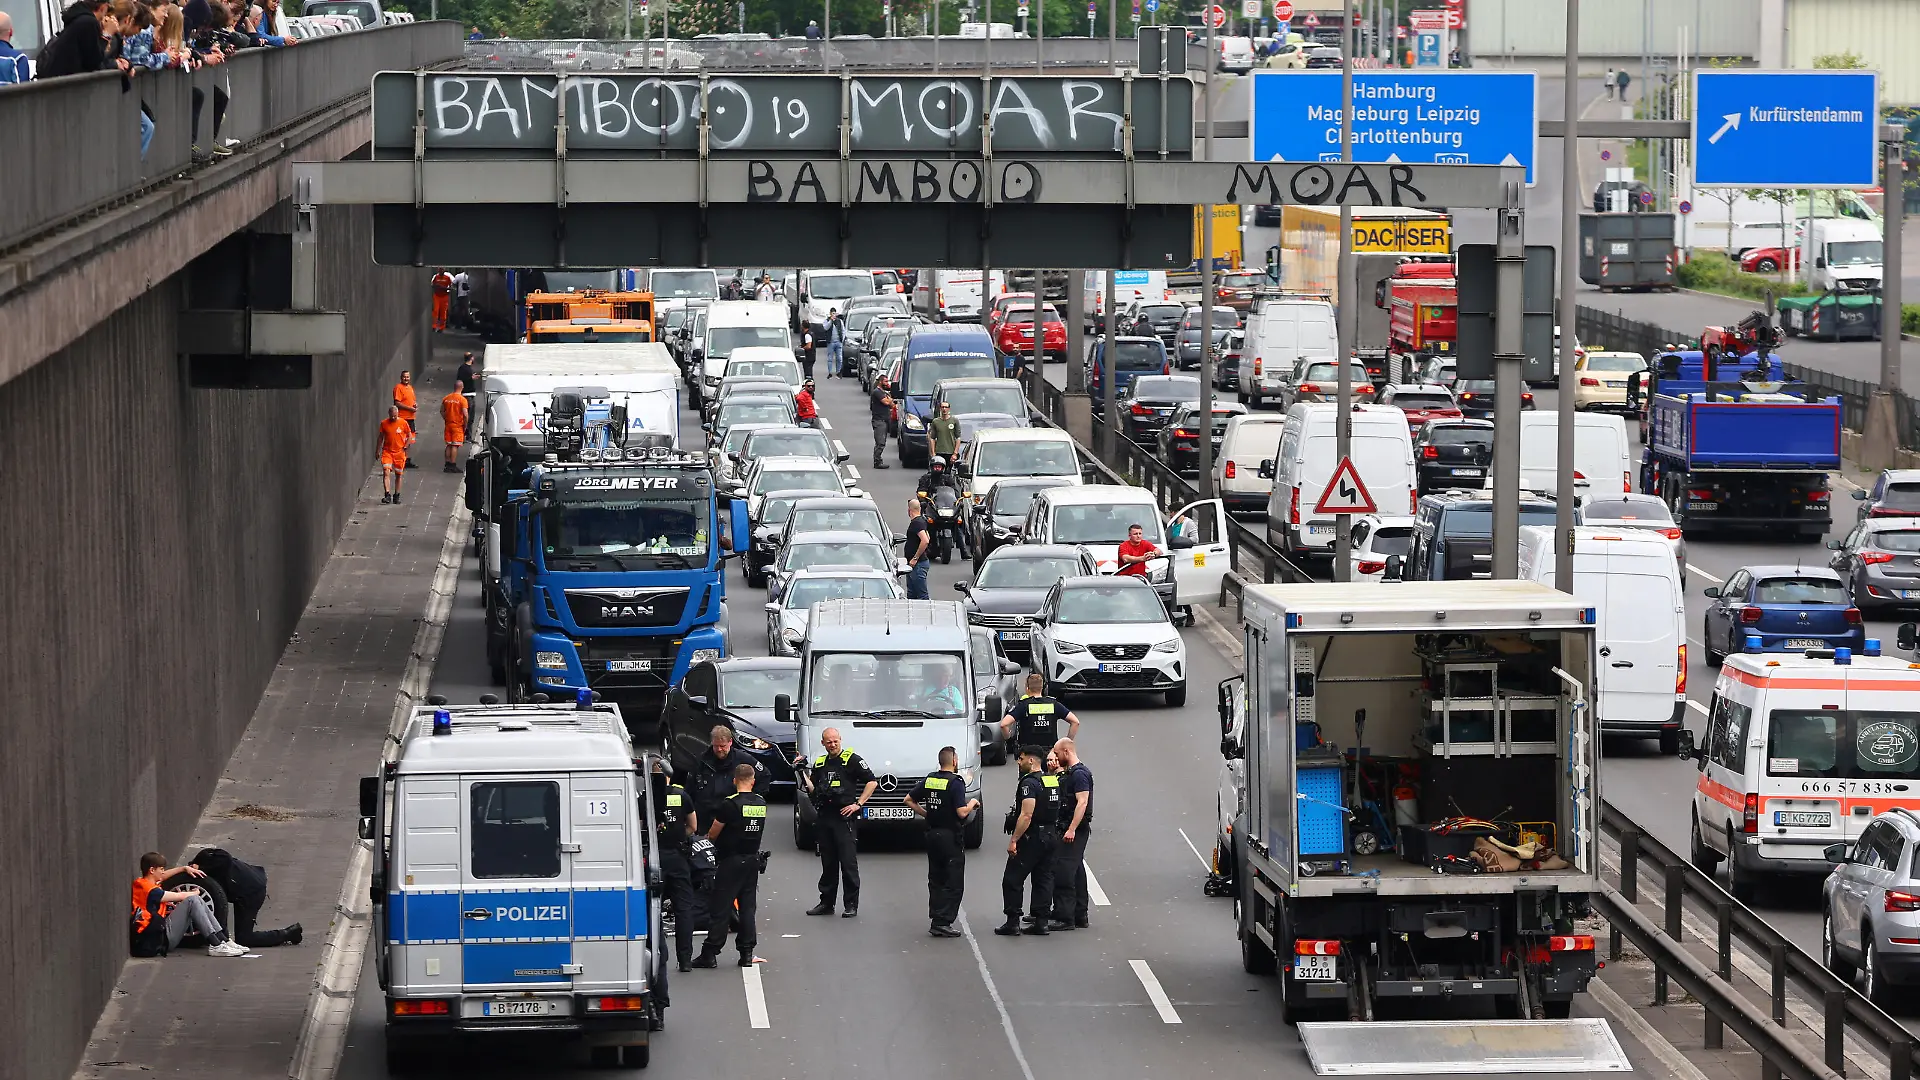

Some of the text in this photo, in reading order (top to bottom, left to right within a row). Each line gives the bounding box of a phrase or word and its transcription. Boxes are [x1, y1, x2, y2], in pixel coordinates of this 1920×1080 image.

[1423, 36, 1435, 50] P
[1352, 82, 1436, 102] Hamburg
[772, 96, 810, 139] 19
[850, 78, 1125, 151] MOAR
[1307, 105, 1480, 125] Mageburg Leipzig
[1750, 106, 1863, 122] Kurfürstendamm
[1226, 164, 1427, 206] MOAR
[1355, 228, 1445, 246] DACHSER
[575, 477, 678, 489] JÖRG MEYER
[601, 606, 654, 617] MAN
[1801, 782, 1892, 793] 666 57 838
[589, 801, 608, 814] 13
[868, 808, 913, 818] B EJ 8383
[1780, 814, 1829, 823] B KG 7723
[496, 906, 567, 921] POLIZEI
[1310, 957, 1318, 967] B
[1299, 967, 1331, 979] 31711
[498, 1002, 539, 1013] B 7178
